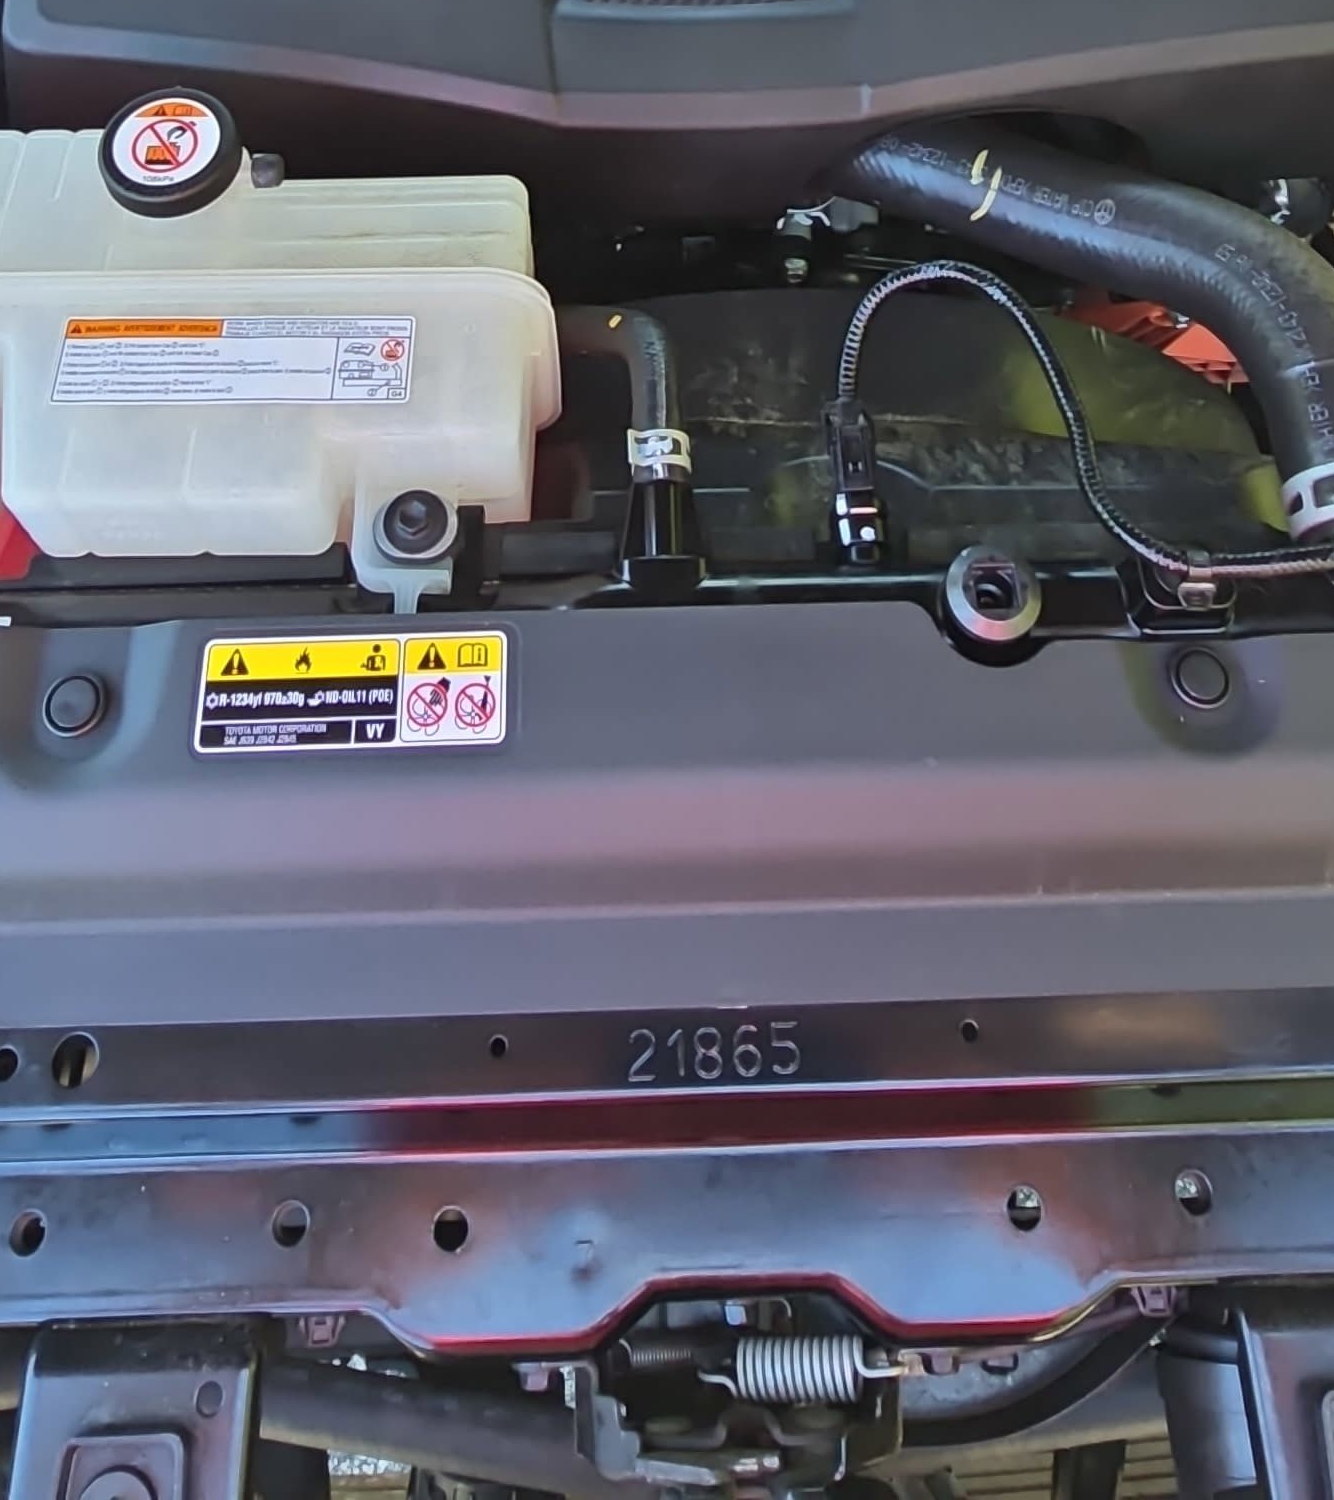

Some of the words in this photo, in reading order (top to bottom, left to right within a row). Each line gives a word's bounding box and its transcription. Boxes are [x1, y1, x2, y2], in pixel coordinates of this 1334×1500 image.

[217, 691, 263, 709] R-1234yf
[368, 689, 394, 705] (POE)
[225, 725, 252, 736] TOYOTA
[252, 724, 278, 735] MOTOR
[278, 723, 327, 734] CORPORATION
[366, 723, 385, 740] VY
[627, 1021, 802, 1083] 21865
